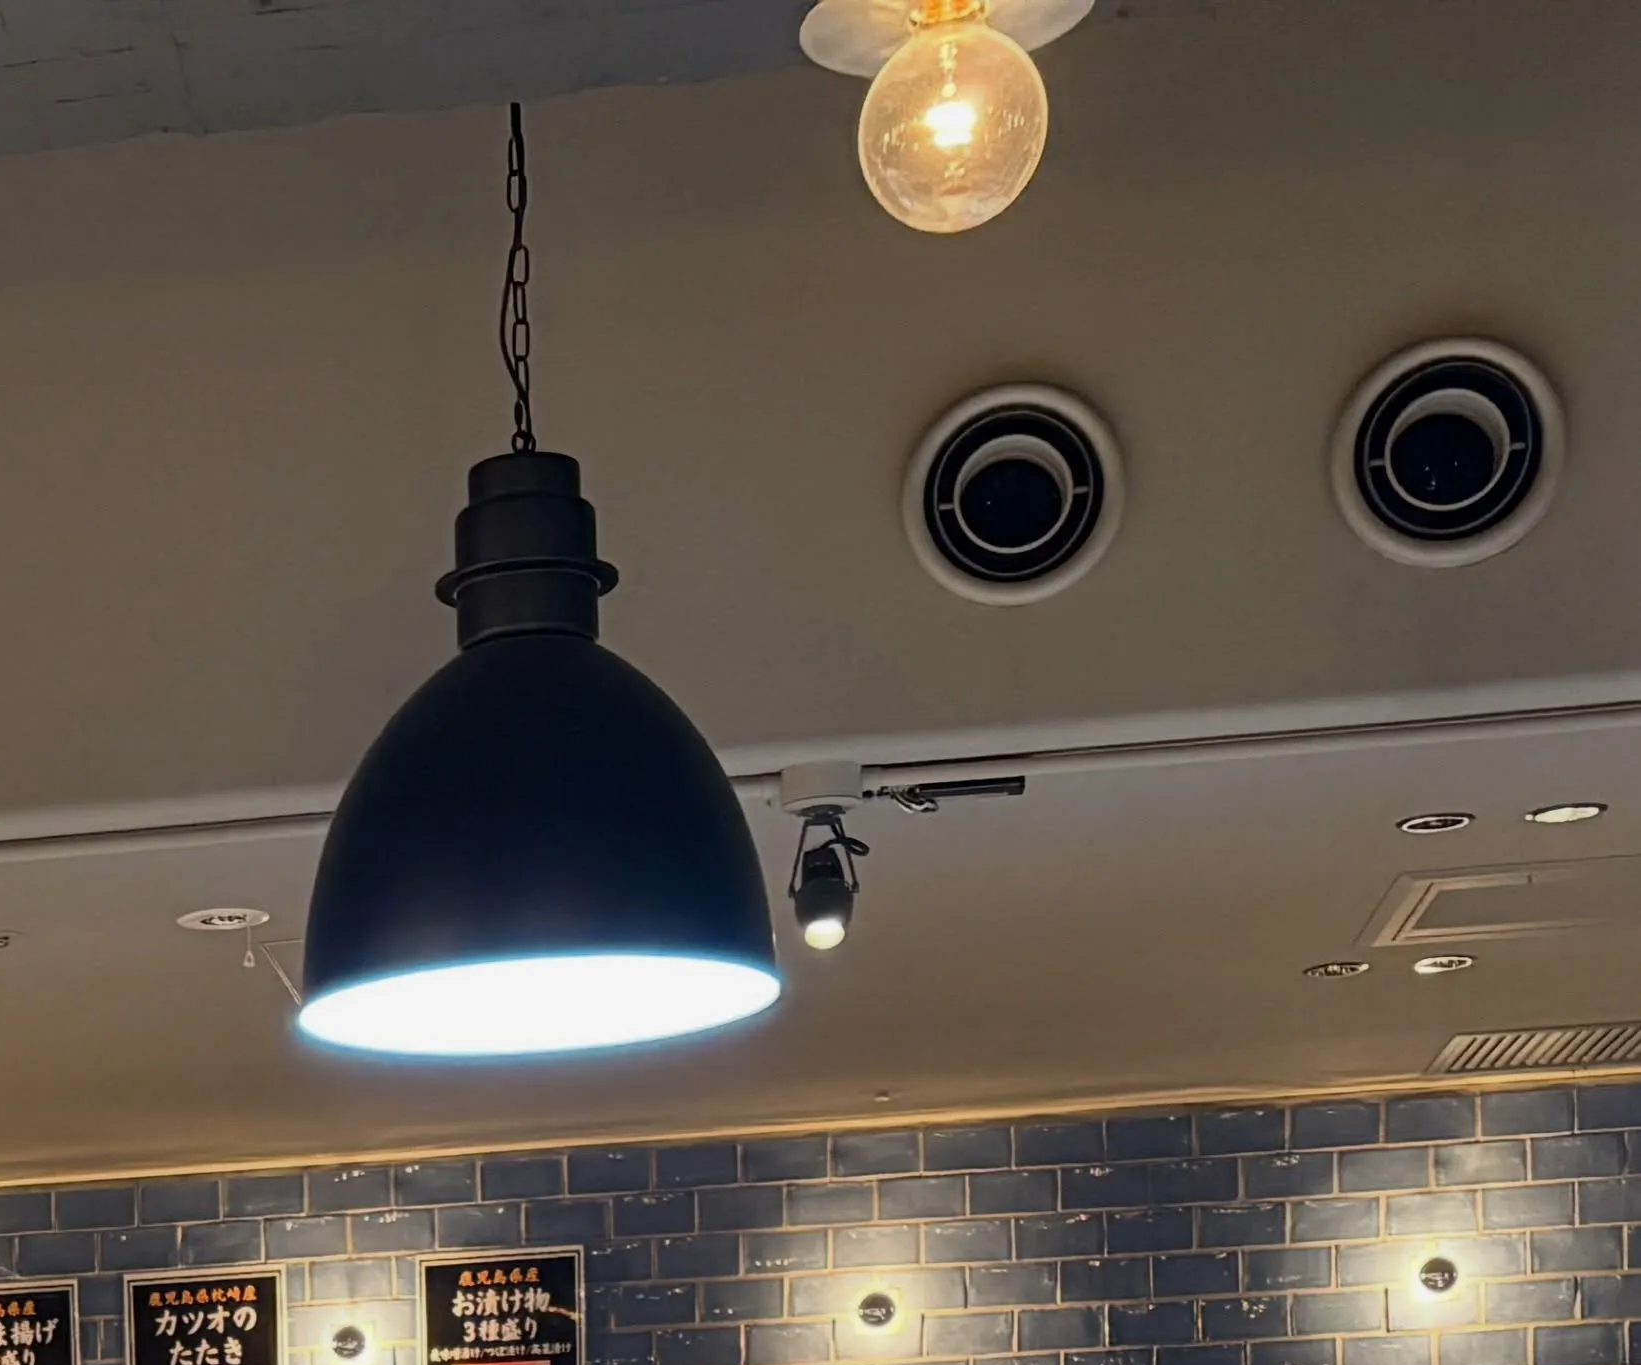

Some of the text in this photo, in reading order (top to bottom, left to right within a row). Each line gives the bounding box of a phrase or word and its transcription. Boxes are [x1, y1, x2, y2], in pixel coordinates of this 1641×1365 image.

[451, 1287, 551, 1317] お漬け物
[154, 1305, 257, 1336] カツオの
[463, 1317, 538, 1343] 3種盛り
